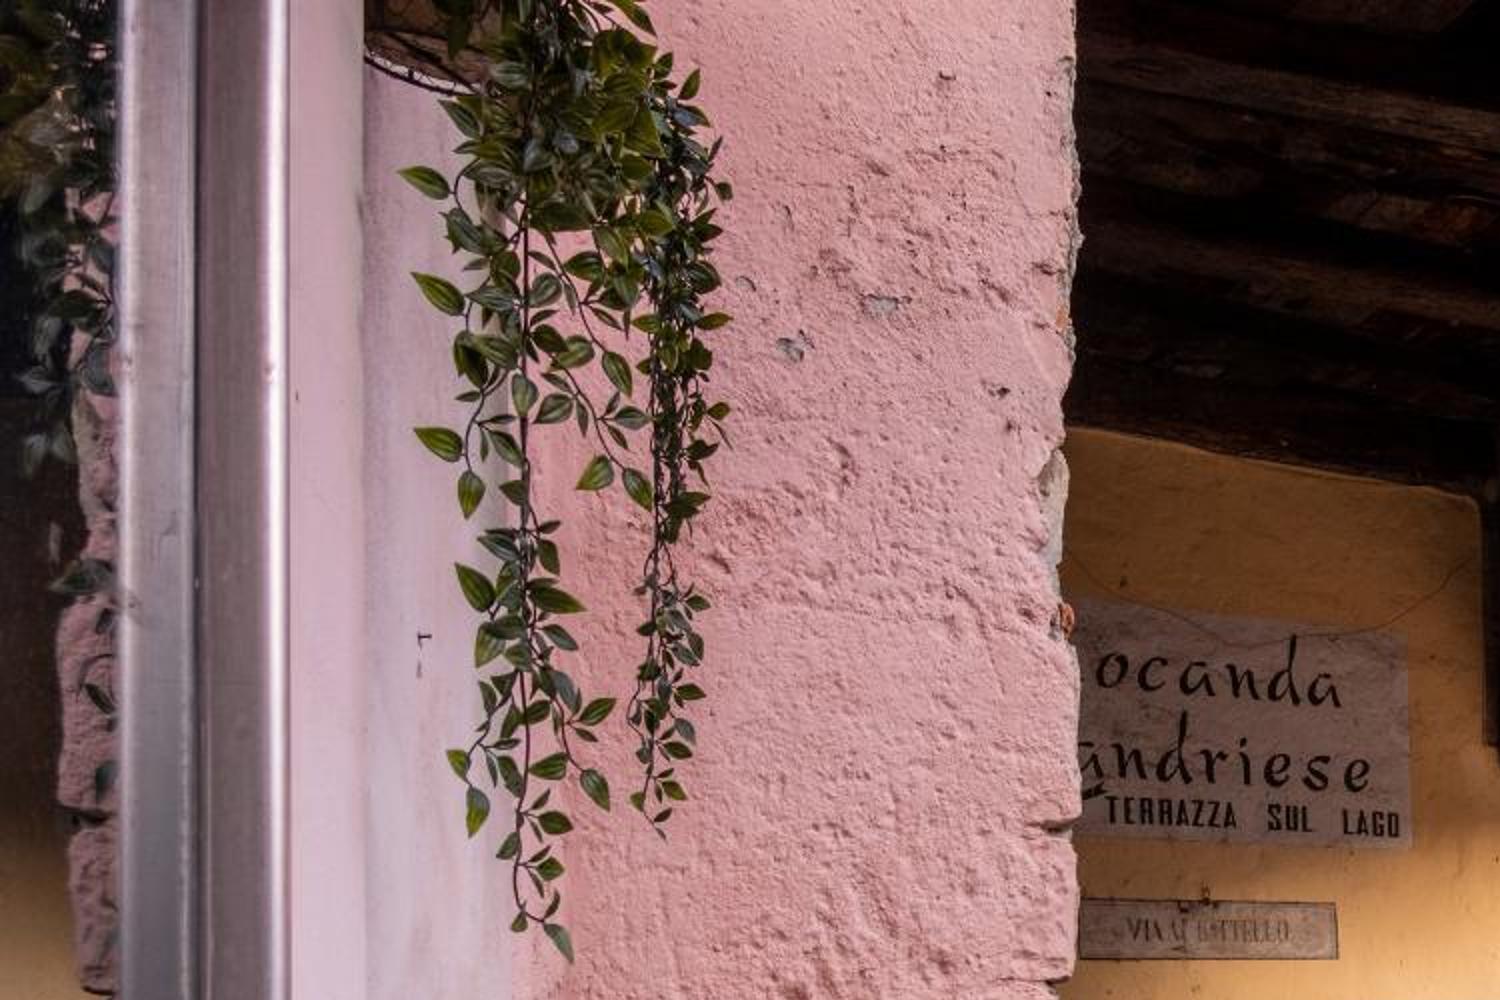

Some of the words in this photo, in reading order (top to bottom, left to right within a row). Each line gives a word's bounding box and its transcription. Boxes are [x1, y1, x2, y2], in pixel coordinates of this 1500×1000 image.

[1095, 633, 1342, 708] ocanda
[1078, 709, 1371, 801] andriese
[1104, 795, 1238, 829] TERRAZZA
[1267, 802, 1314, 833] SUL
[1341, 808, 1401, 839] LAGO
